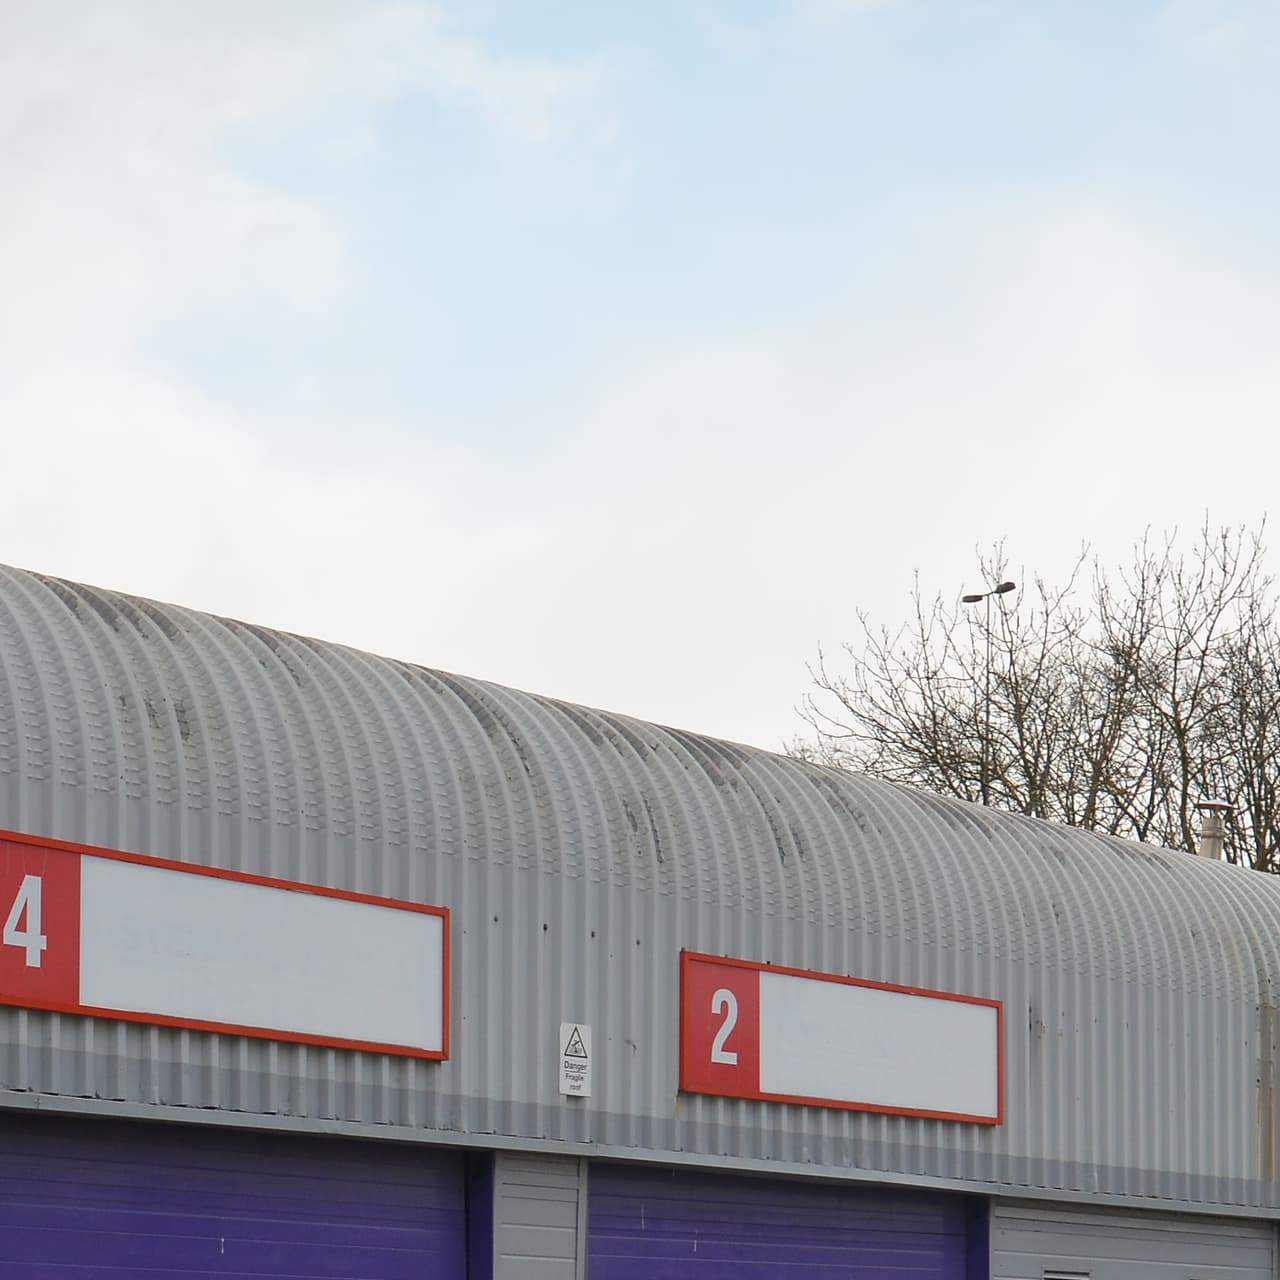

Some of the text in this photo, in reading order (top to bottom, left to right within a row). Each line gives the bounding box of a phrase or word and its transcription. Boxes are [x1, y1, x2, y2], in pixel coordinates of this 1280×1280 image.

[3, 874, 47, 968] 4
[711, 988, 738, 1065] 2
[564, 1061, 587, 1072] Danger
